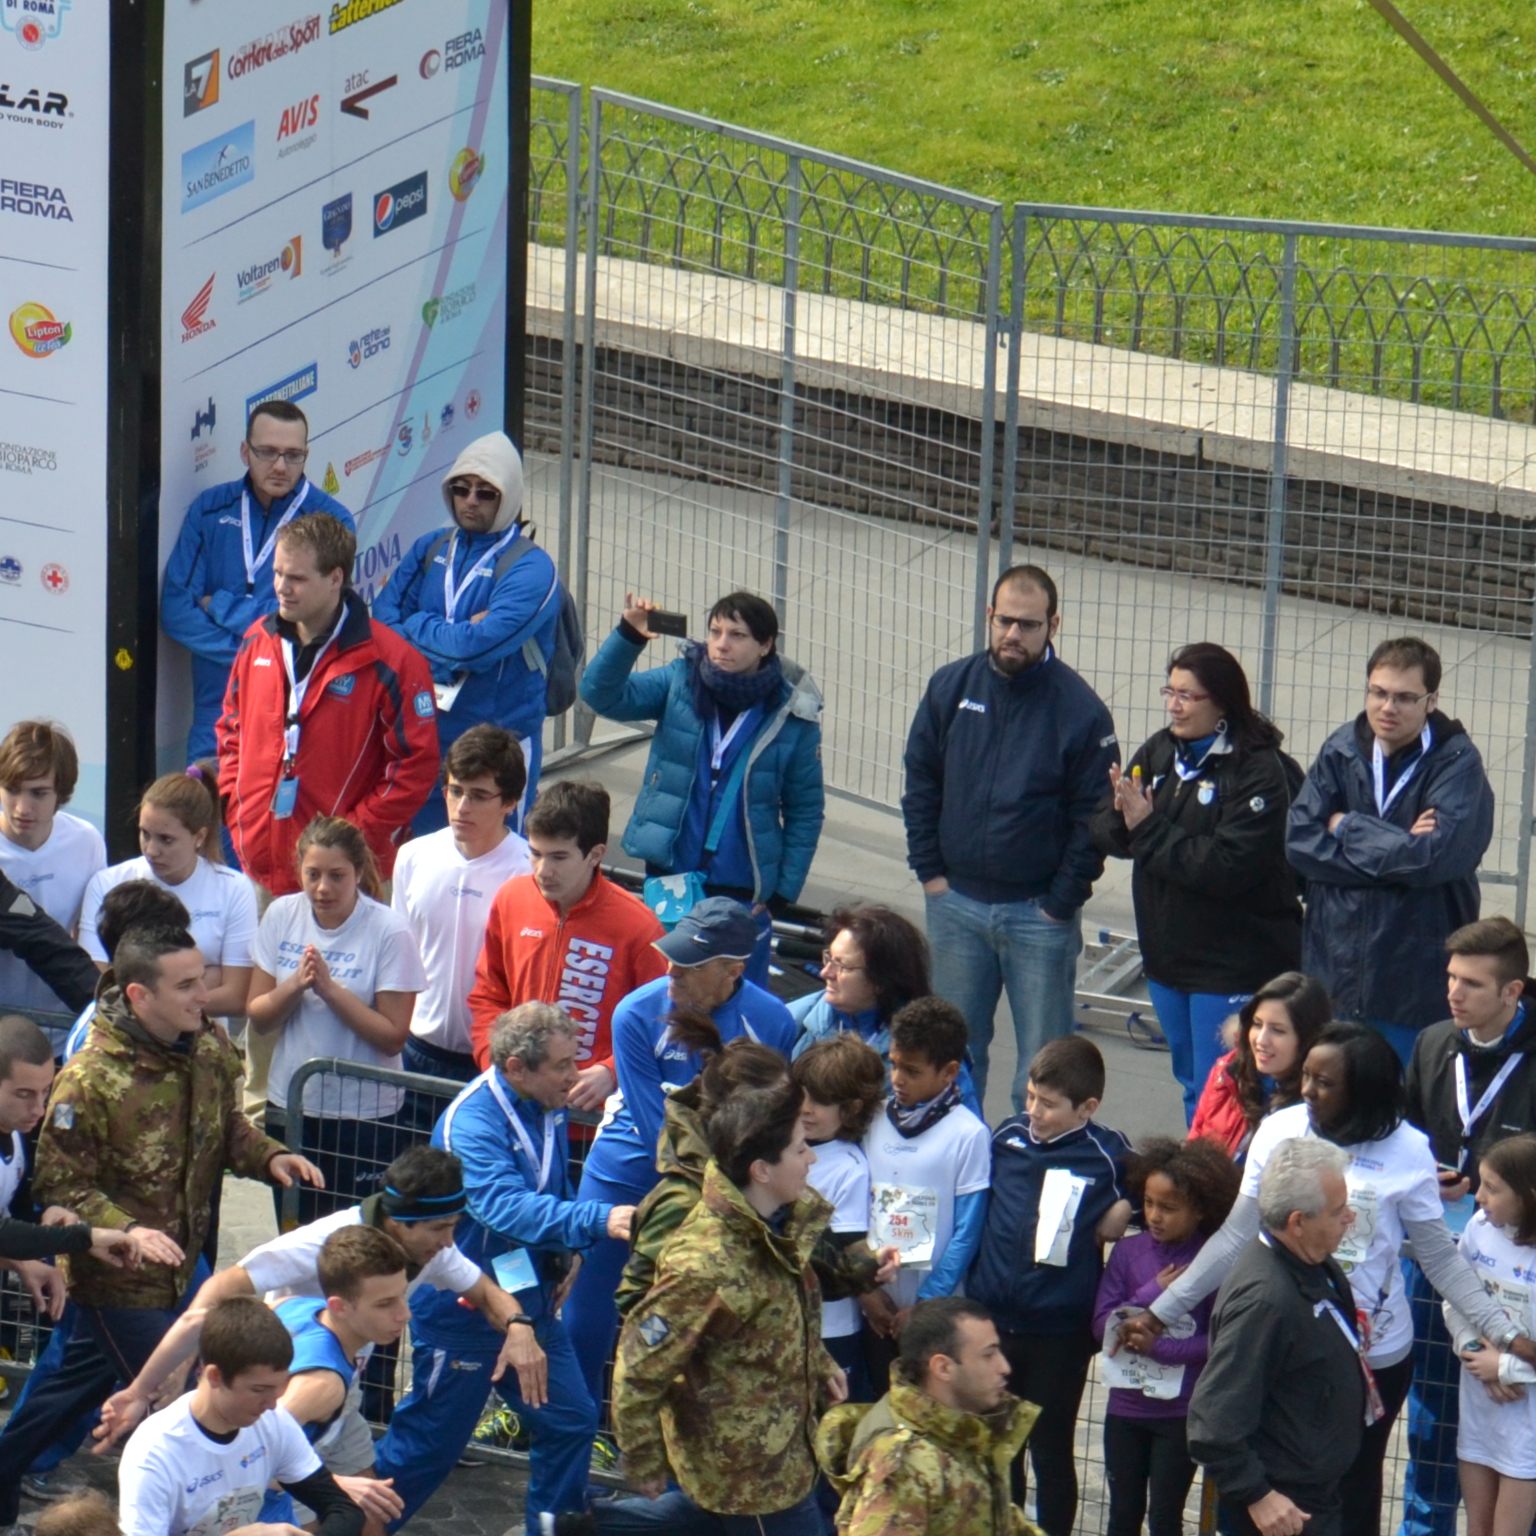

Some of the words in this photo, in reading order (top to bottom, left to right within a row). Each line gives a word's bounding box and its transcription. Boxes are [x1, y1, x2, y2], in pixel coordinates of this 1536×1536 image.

[445, 28, 483, 56] FIERA
[445, 42, 487, 73] ROMA
[344, 69, 370, 94] atac
[6, 112, 34, 125] YOUR
[36, 116, 64, 130] BODY
[277, 94, 320, 142] AVIS
[0, 178, 67, 204] FIERA
[395, 185, 425, 213] pepsi
[0, 196, 74, 222] ROMA
[236, 257, 280, 289] Voltaren
[27, 325, 62, 339] Lipton
[181, 318, 217, 344] HONDA
[887, 1213, 910, 1227] 254
[889, 1226, 915, 1239] 5km
[196, 1470, 221, 1488] asics
